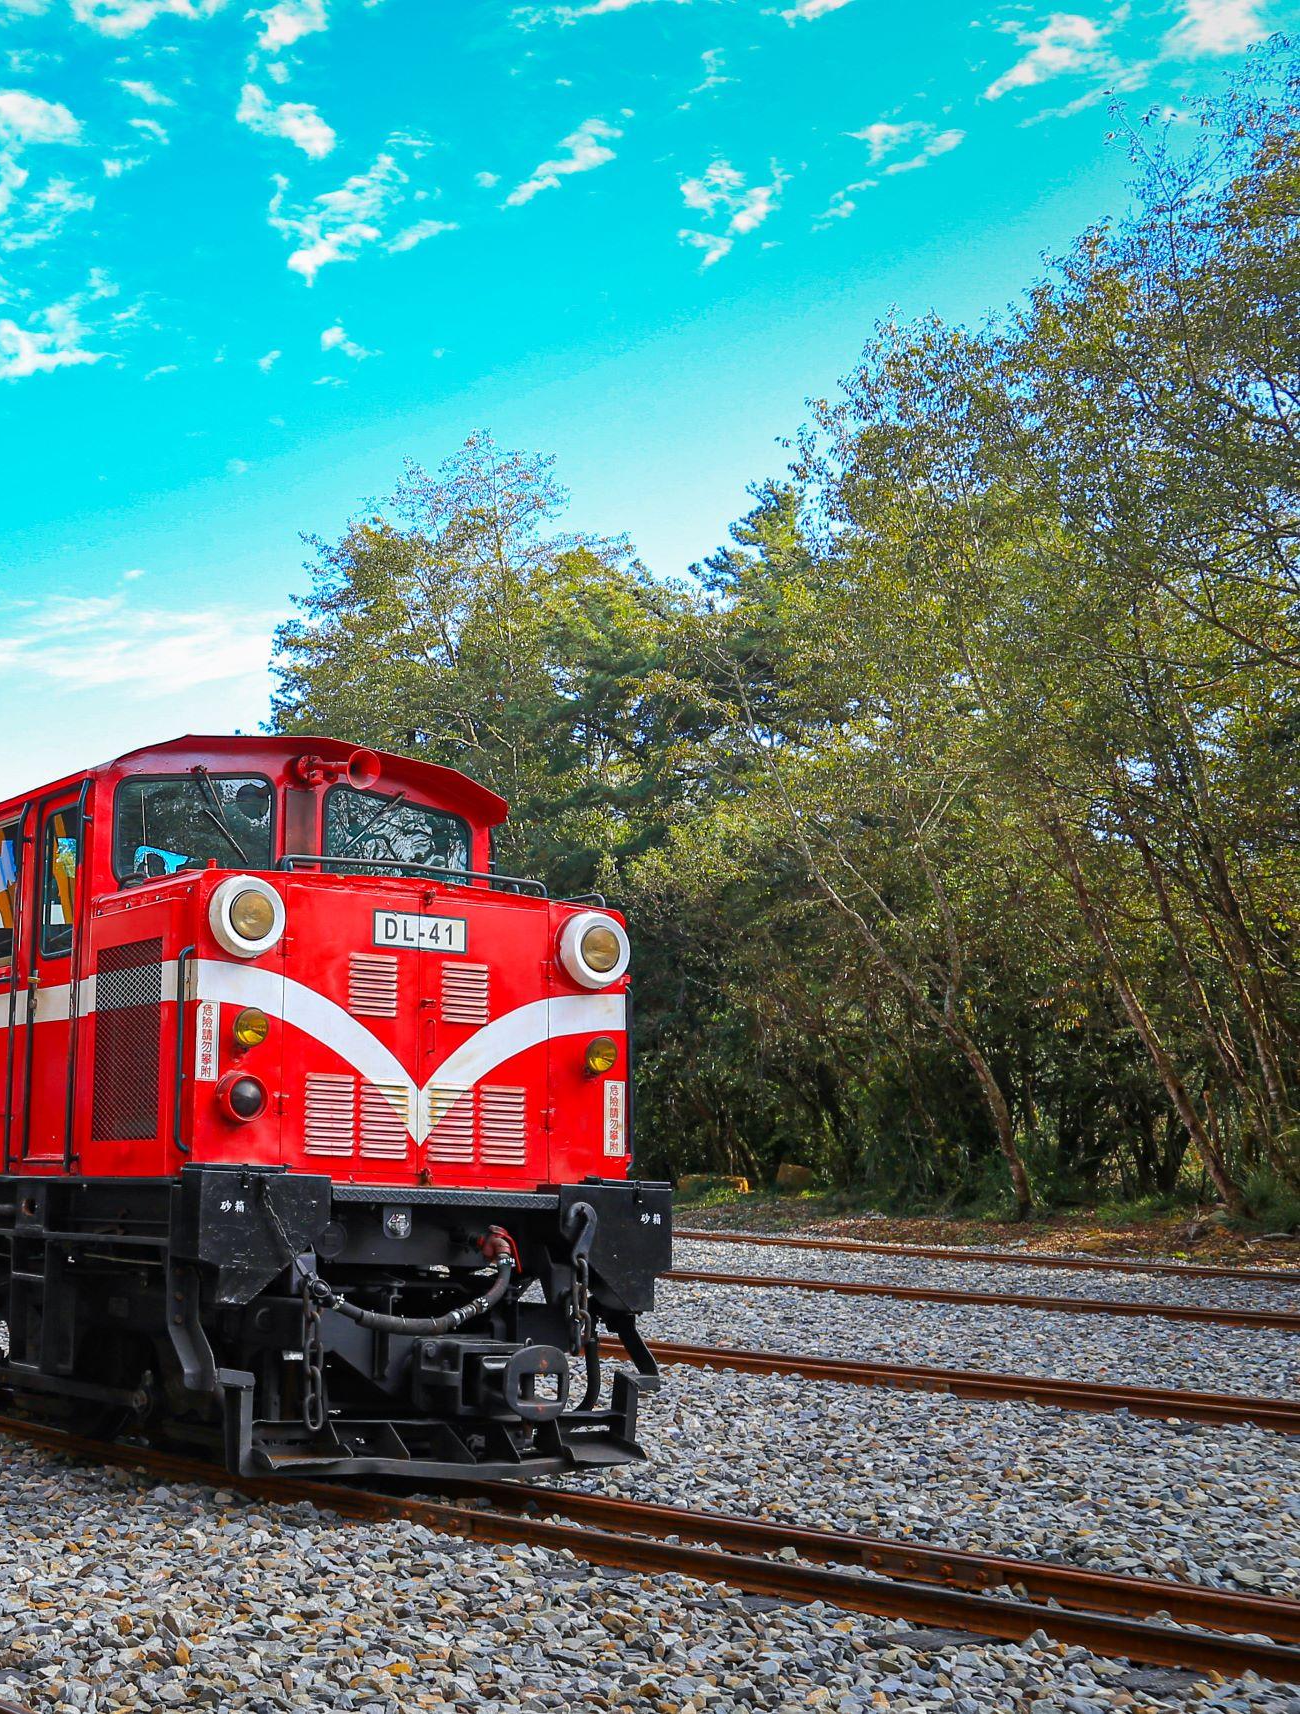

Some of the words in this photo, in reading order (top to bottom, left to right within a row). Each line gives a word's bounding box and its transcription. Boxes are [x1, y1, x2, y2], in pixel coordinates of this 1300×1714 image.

[384, 917, 454, 946] DL-41
[201, 1004, 213, 1078] 危險請勿攀附
[609, 1084, 619, 1153] 危險請勿攀附
[219, 1199, 245, 1213] 砂箱
[640, 1212, 661, 1225] 砂箱
